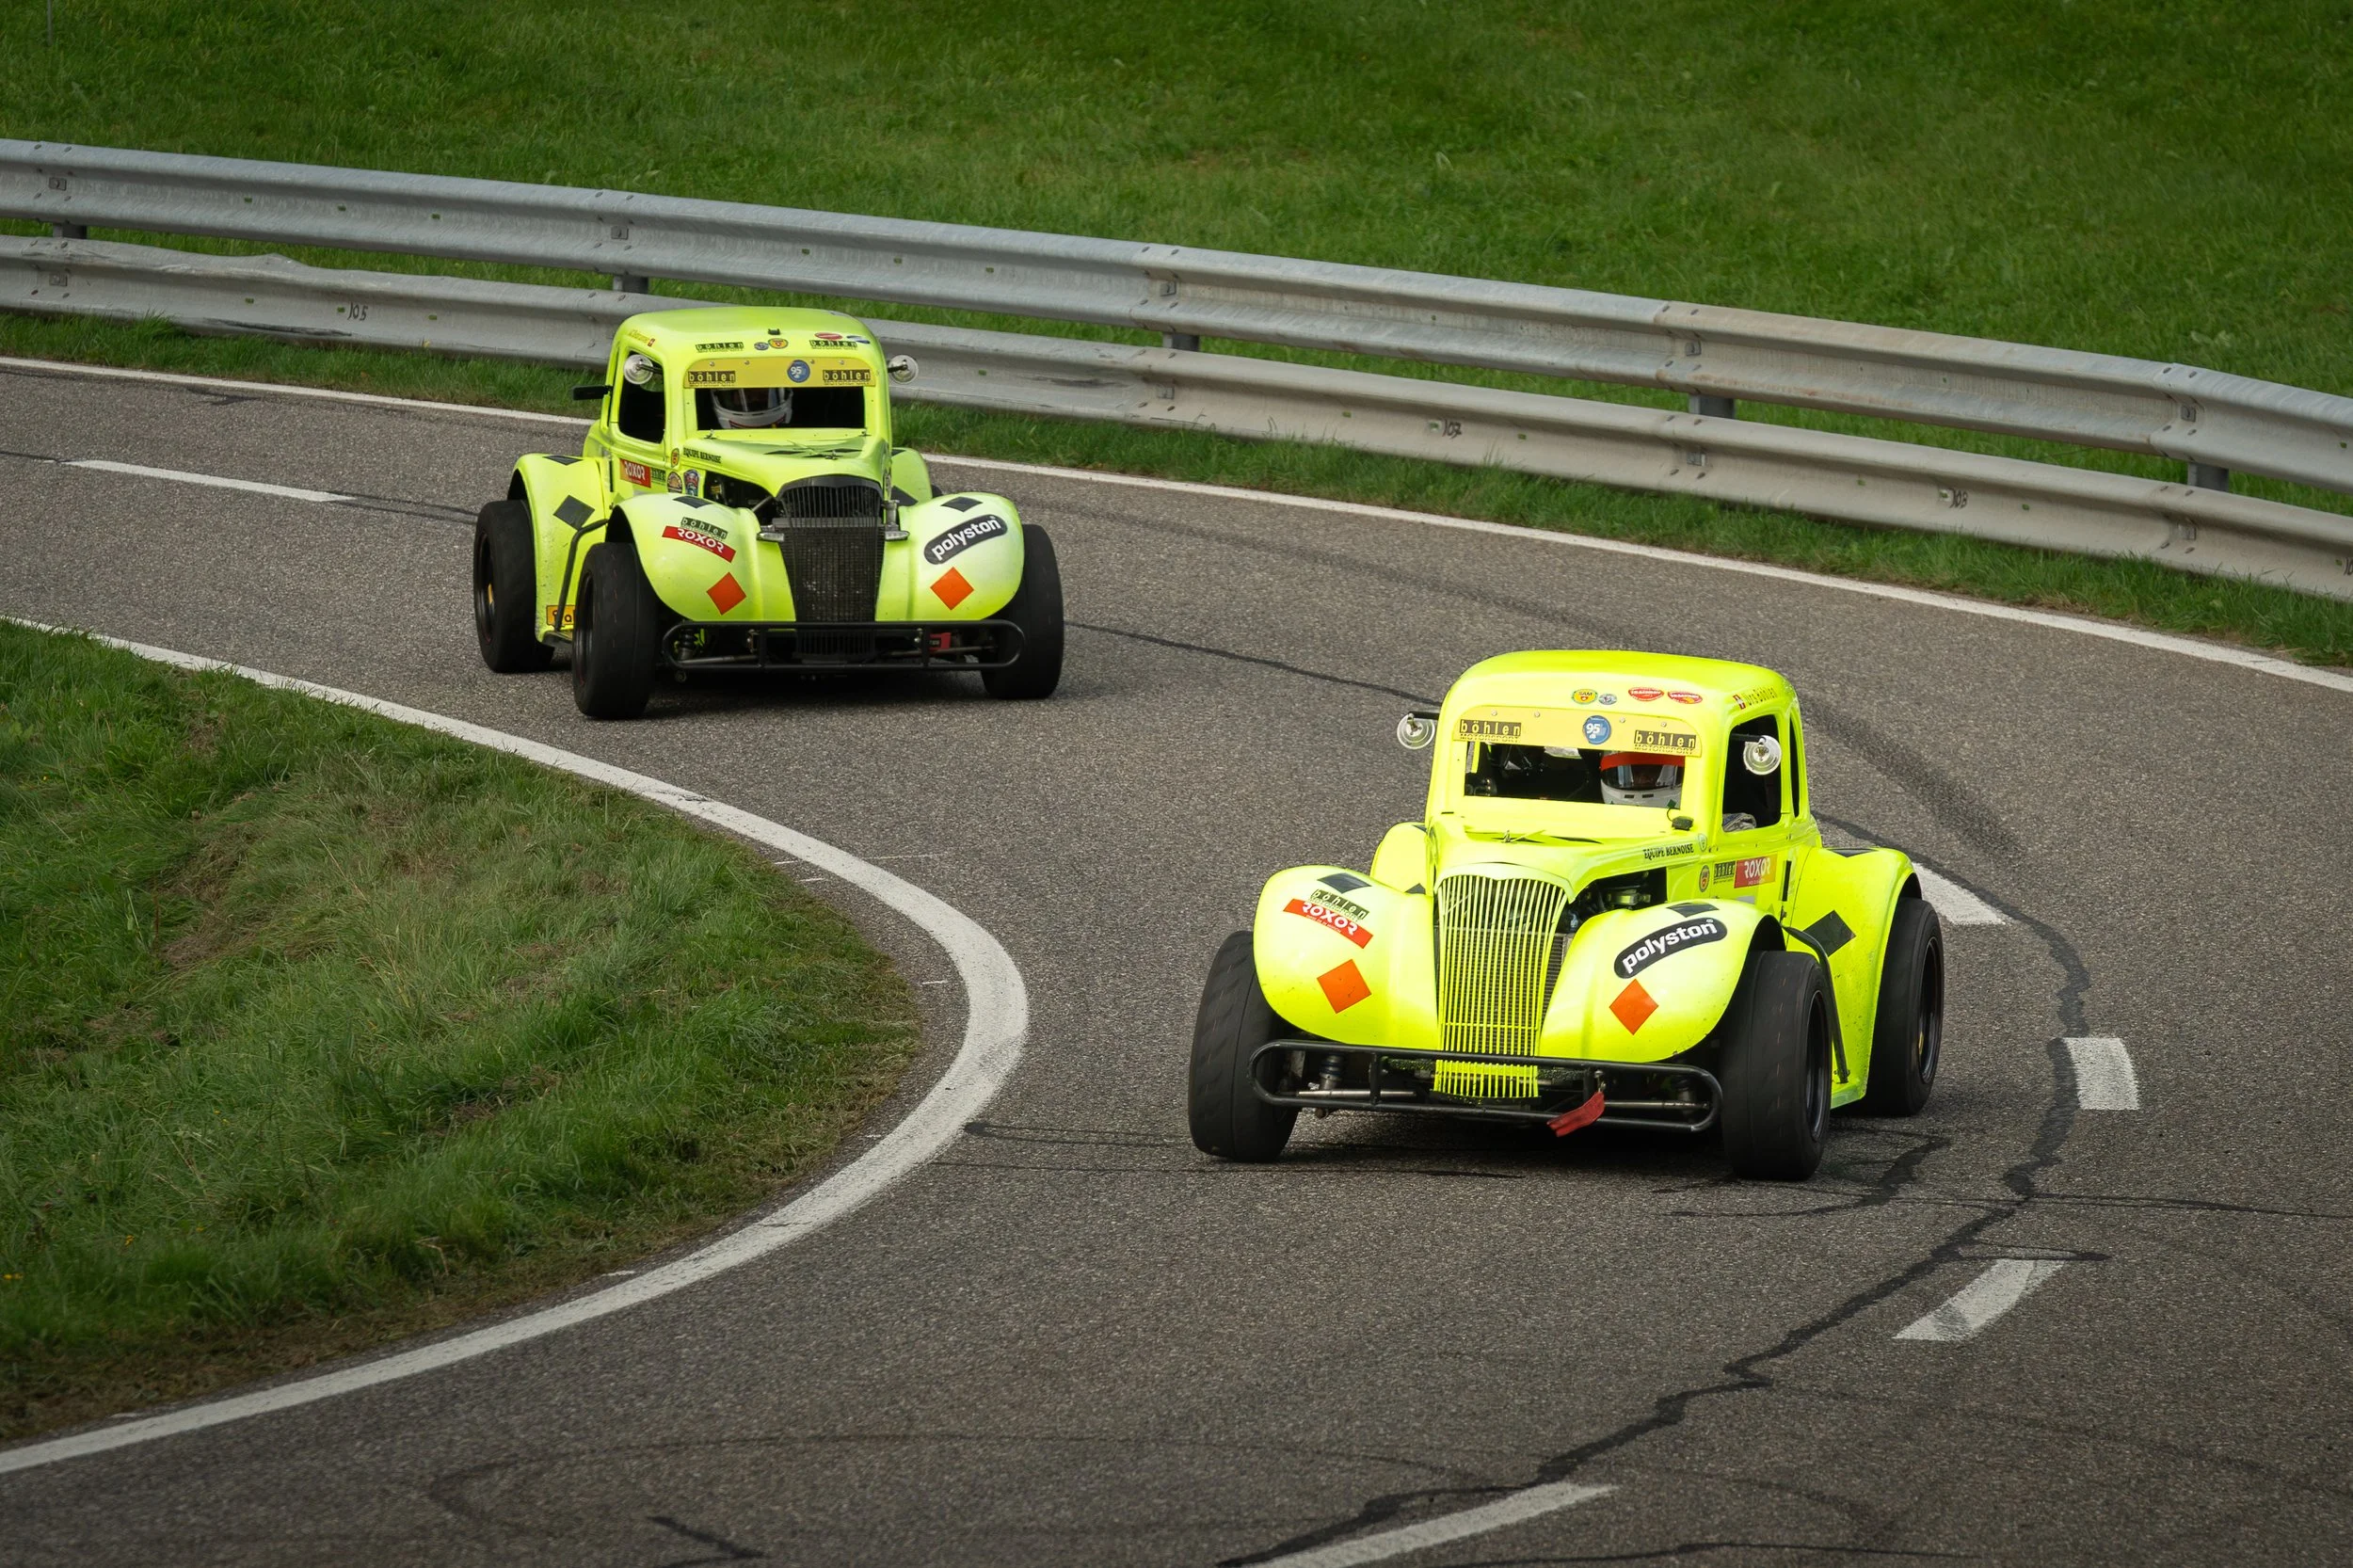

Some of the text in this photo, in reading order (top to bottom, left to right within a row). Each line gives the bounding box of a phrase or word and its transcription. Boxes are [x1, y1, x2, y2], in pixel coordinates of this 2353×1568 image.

[347, 301, 368, 321] 105
[790, 366, 802, 375] 95
[624, 460, 646, 480] ROXOR
[678, 528, 724, 553] ROXOR
[931, 518, 1001, 561] polyston
[1460, 720, 1521, 736] böhlen
[1586, 723, 1600, 734] 95
[1635, 730, 1695, 748] böhlen
[1642, 843, 1693, 860] EQUIPE BERNOISE
[1744, 857, 1771, 879] ROXOR
[1303, 901, 1358, 936] ROXOR
[1622, 921, 1718, 974] polyston
